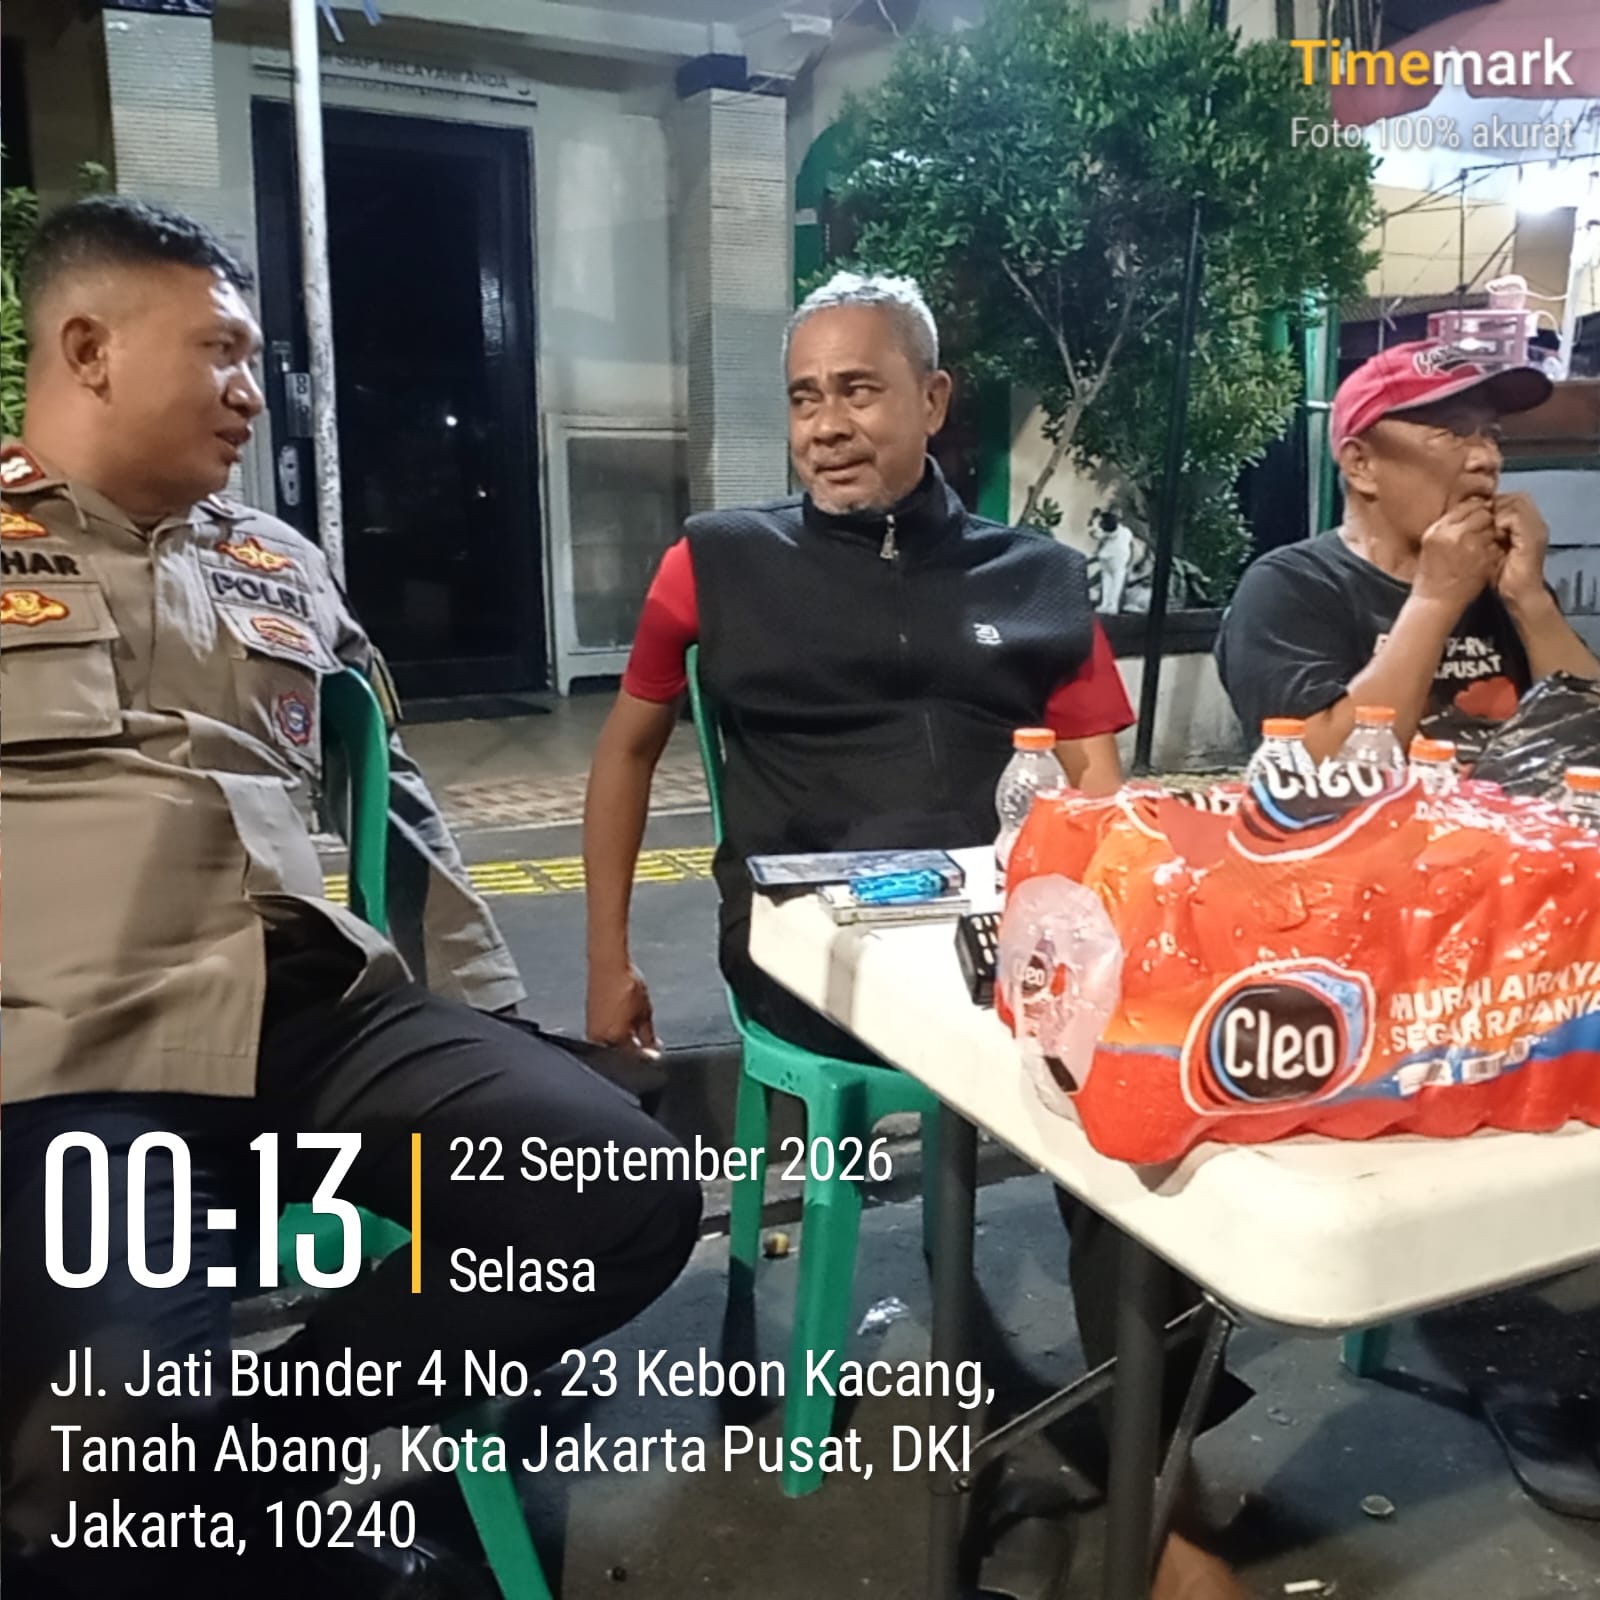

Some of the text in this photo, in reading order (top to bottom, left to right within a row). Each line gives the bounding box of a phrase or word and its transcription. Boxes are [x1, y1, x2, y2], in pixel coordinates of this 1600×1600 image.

[464, 69, 510, 89] ANDA
[212, 572, 311, 618] POLRI
[1225, 1007, 1334, 1080] Cleo
